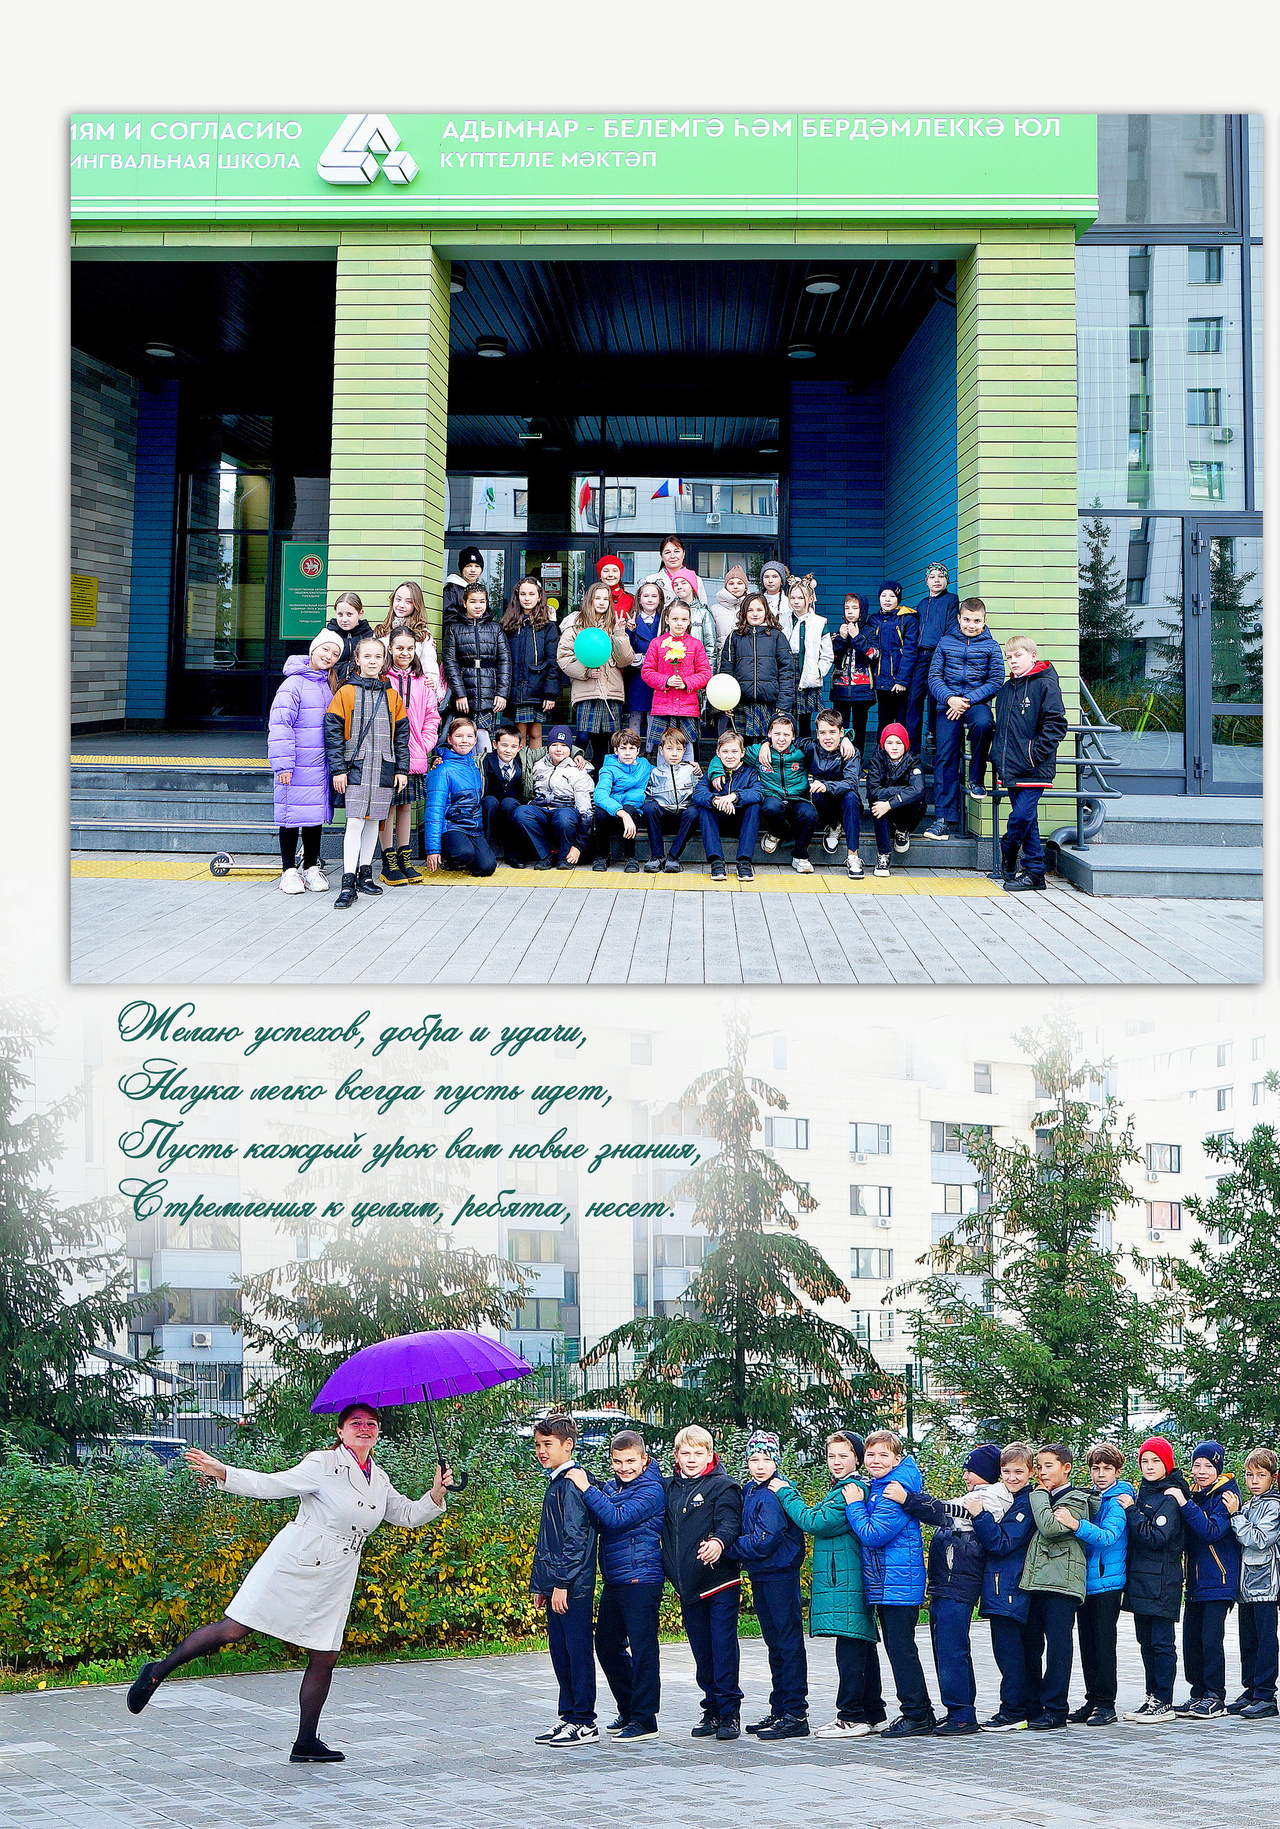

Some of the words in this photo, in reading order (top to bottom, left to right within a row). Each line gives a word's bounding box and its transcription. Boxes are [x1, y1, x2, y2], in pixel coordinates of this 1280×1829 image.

[124, 122, 142, 141] И
[150, 120, 303, 141] СОГЛАСИЮ
[442, 119, 579, 142] АДЫМНАР
[604, 118, 725, 138] БЕЛЕМГӘ
[802, 117, 1005, 141] БЕРДӘМЛЕККӘ
[1014, 117, 1060, 137] ЮЛ
[217, 152, 301, 169] ШКОЛА
[440, 151, 554, 168] КҮПТЕЛЛЕ
[561, 151, 657, 168] МӘКТӘП
